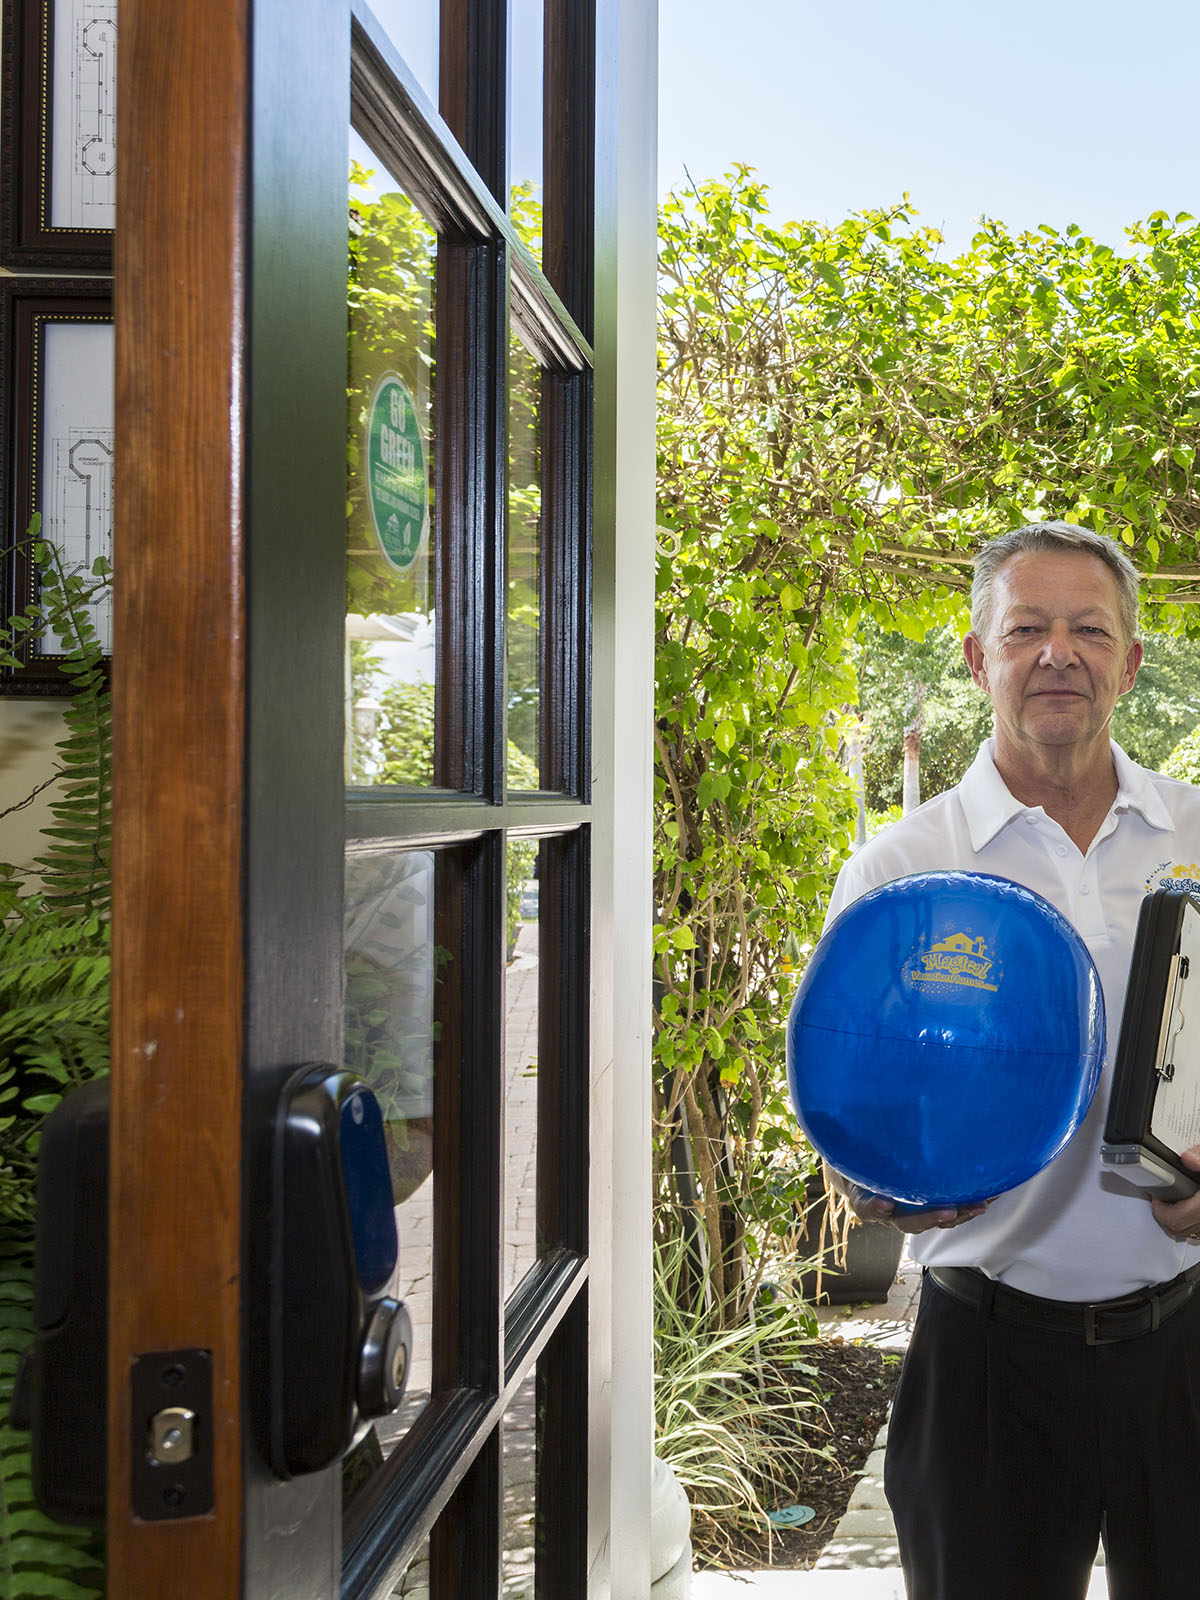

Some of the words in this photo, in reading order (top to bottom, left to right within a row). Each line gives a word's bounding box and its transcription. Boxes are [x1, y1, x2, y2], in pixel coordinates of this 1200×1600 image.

[390, 388, 406, 433] GO
[380, 423, 415, 478] GREEN
[921, 953, 992, 980] Magical
